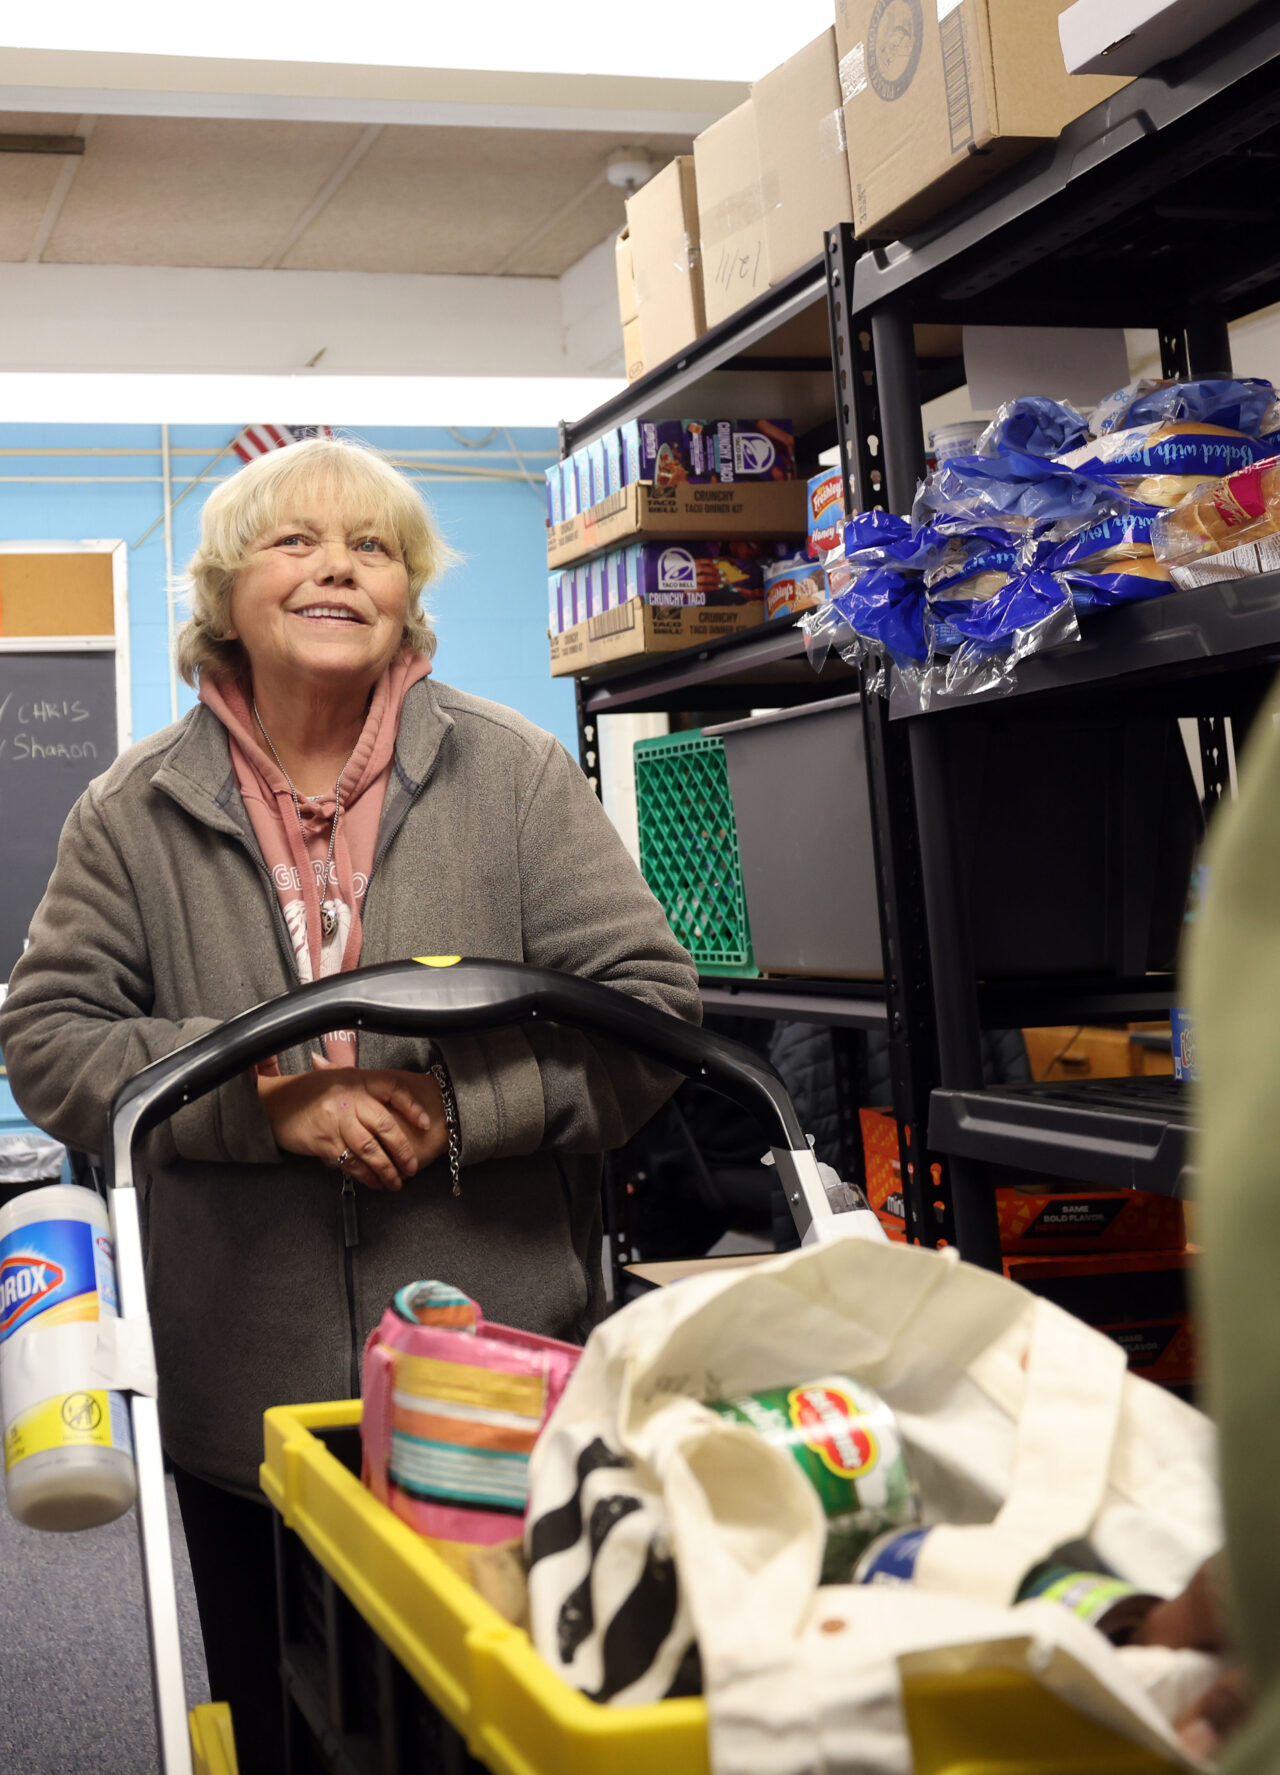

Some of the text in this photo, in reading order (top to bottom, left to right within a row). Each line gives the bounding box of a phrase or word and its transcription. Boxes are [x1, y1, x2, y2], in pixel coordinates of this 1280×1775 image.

[1155, 443, 1197, 464] with
[1201, 444, 1253, 467] Baked
[694, 490, 734, 501] CRUNCHY
[685, 504, 703, 513] TACO
[812, 526, 834, 543] Honey
[649, 592, 706, 605] CRUNCHY TACO
[699, 612, 738, 622] CRUNCHY
[690, 625, 706, 634] TACO
[18, 701, 90, 724] CHRIS
[1062, 1205, 1089, 1213] SAME
[1044, 1215, 1068, 1223] BOLD
